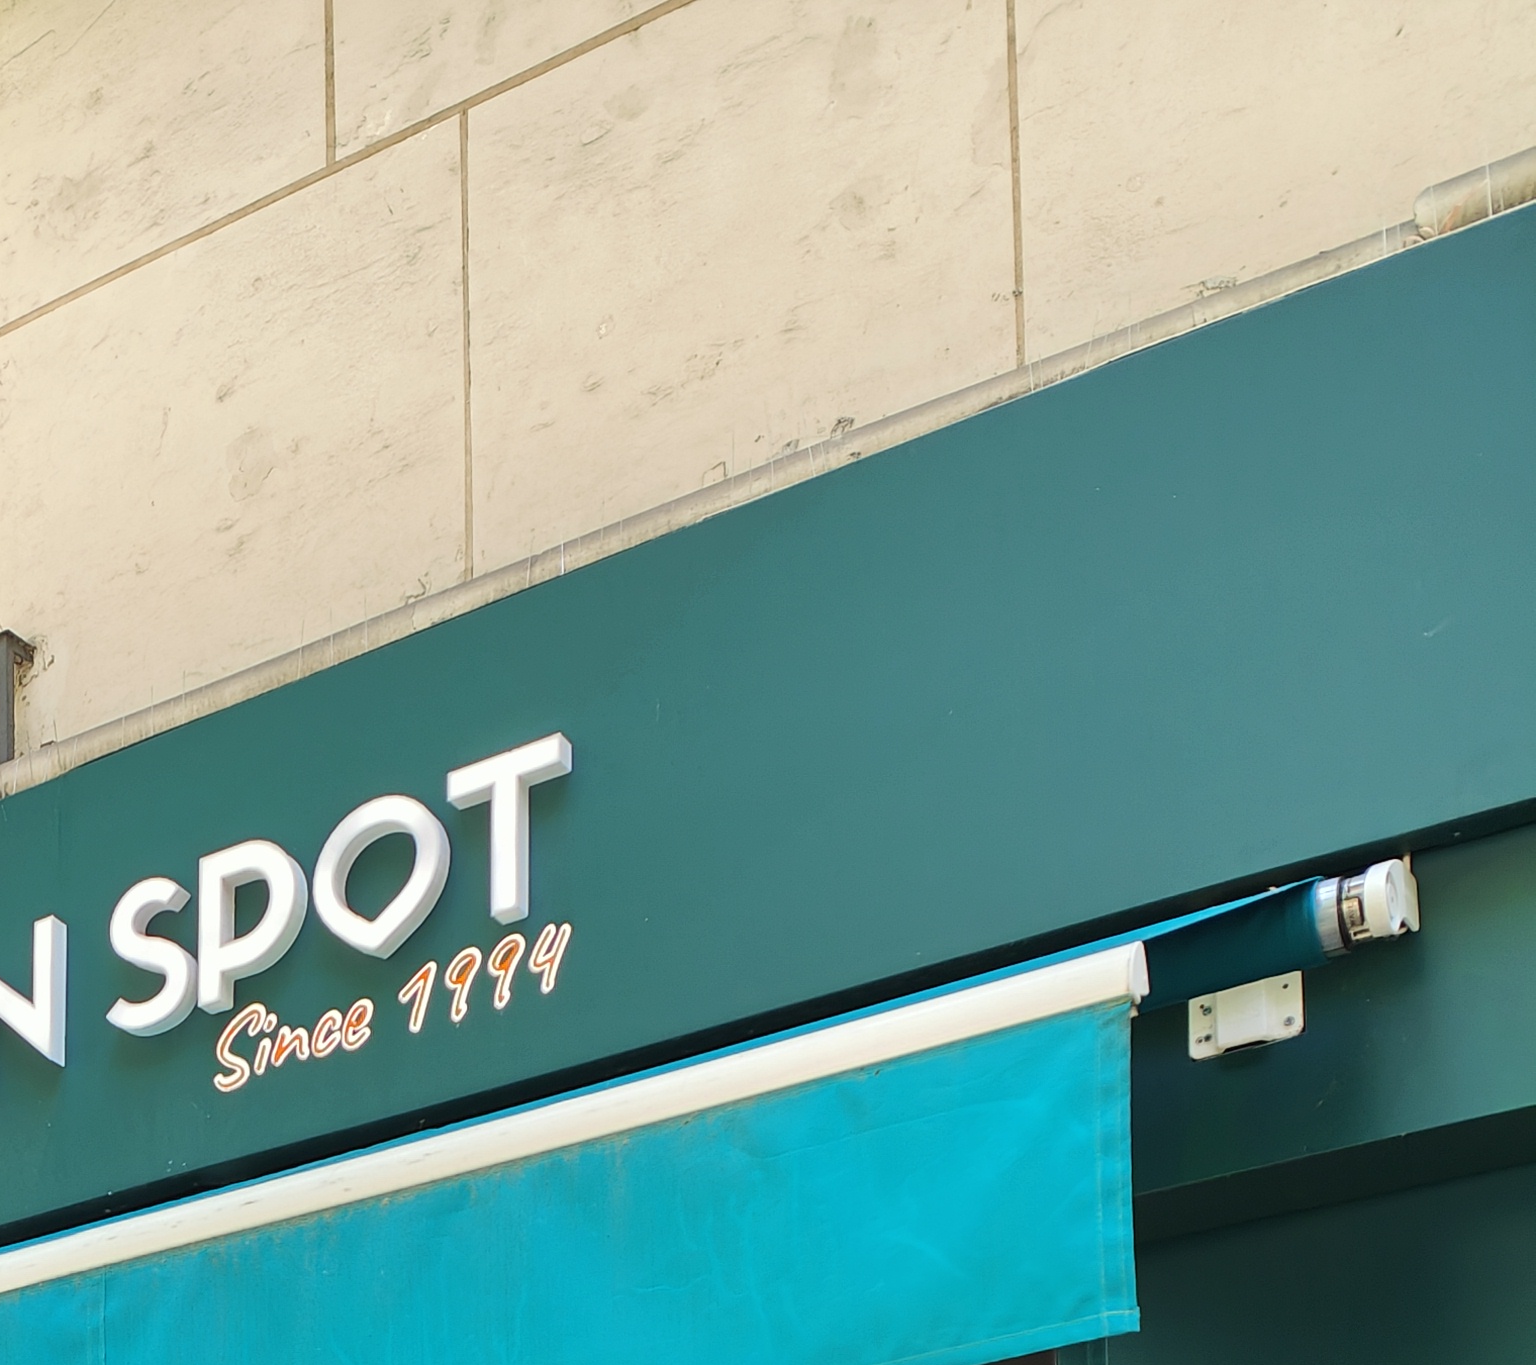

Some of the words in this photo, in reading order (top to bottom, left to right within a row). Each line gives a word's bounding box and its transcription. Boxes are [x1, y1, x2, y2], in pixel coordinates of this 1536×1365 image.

[106, 733, 573, 1037] SPOT
[214, 998, 375, 1092] Since
[397, 922, 573, 1034] 1994
